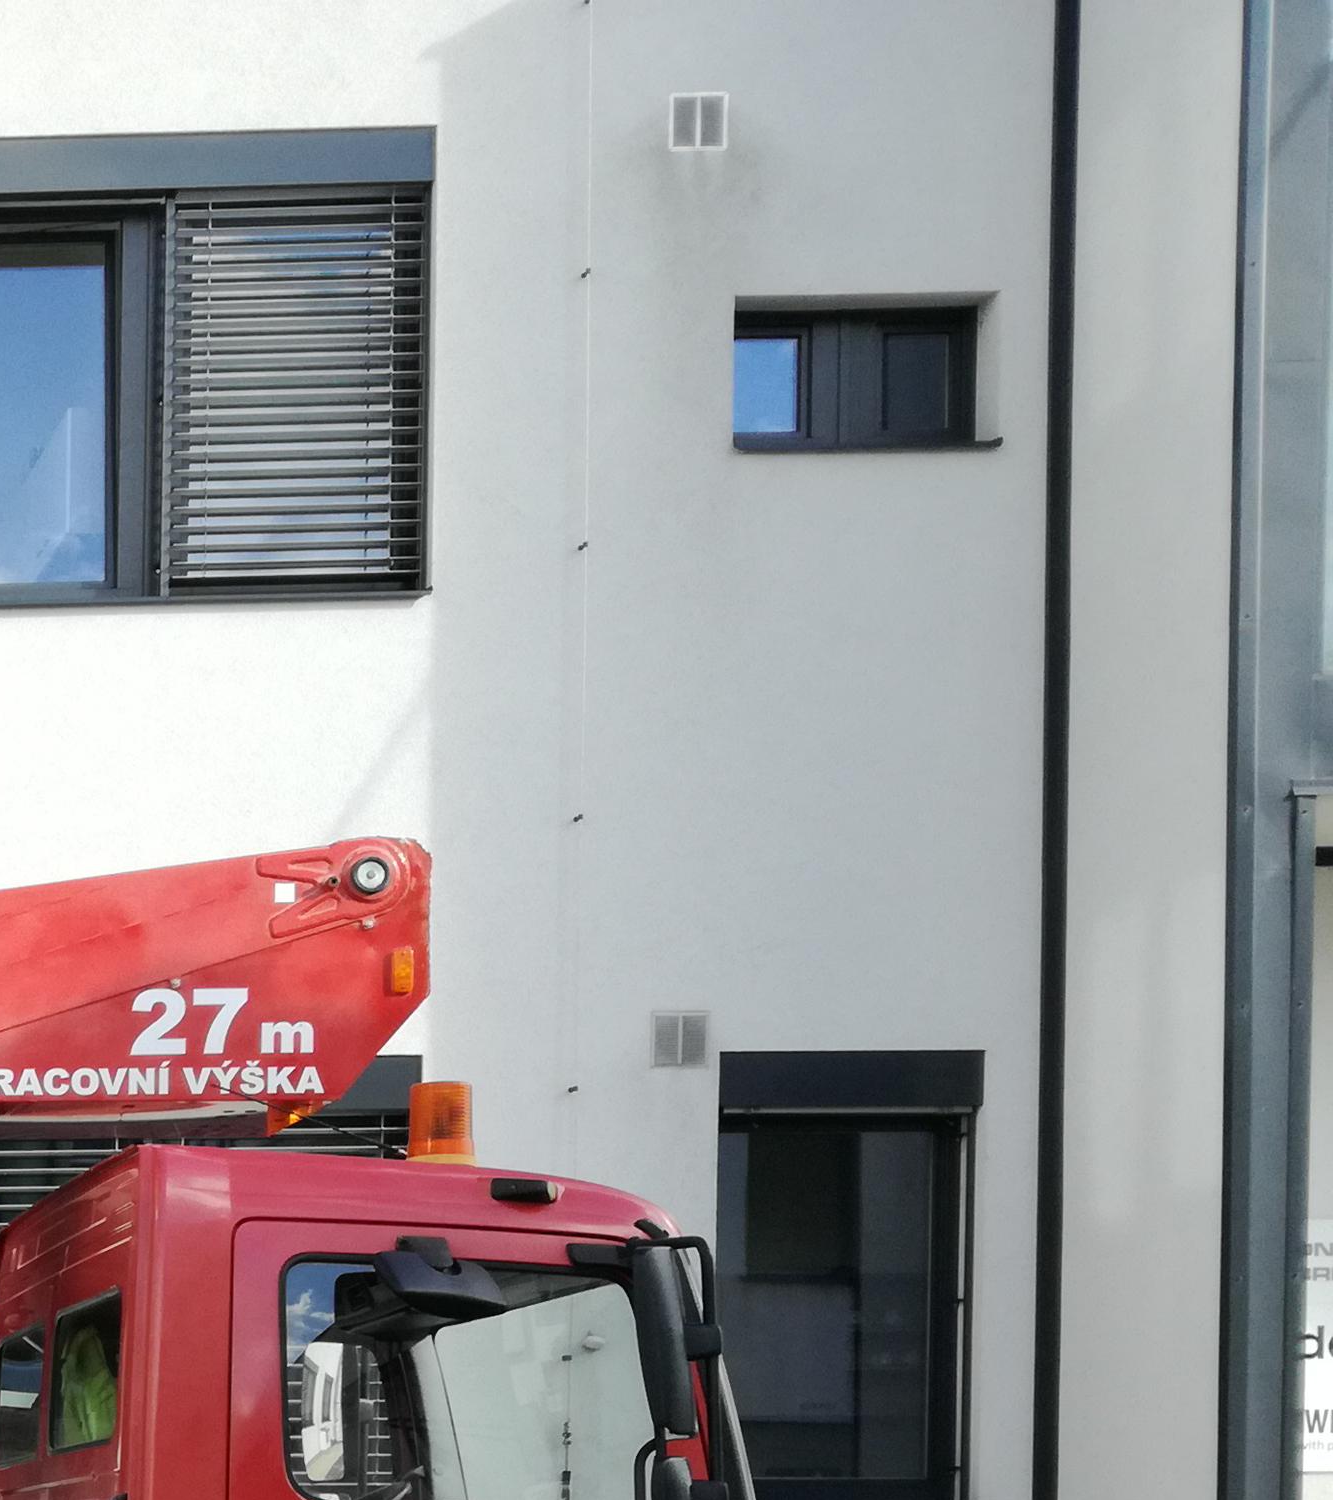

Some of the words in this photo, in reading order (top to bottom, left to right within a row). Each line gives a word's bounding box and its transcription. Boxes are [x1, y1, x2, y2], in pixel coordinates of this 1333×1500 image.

[129, 987, 250, 1057] 27
[260, 1020, 315, 1055] m
[181, 1060, 325, 1096] VÝŠKA
